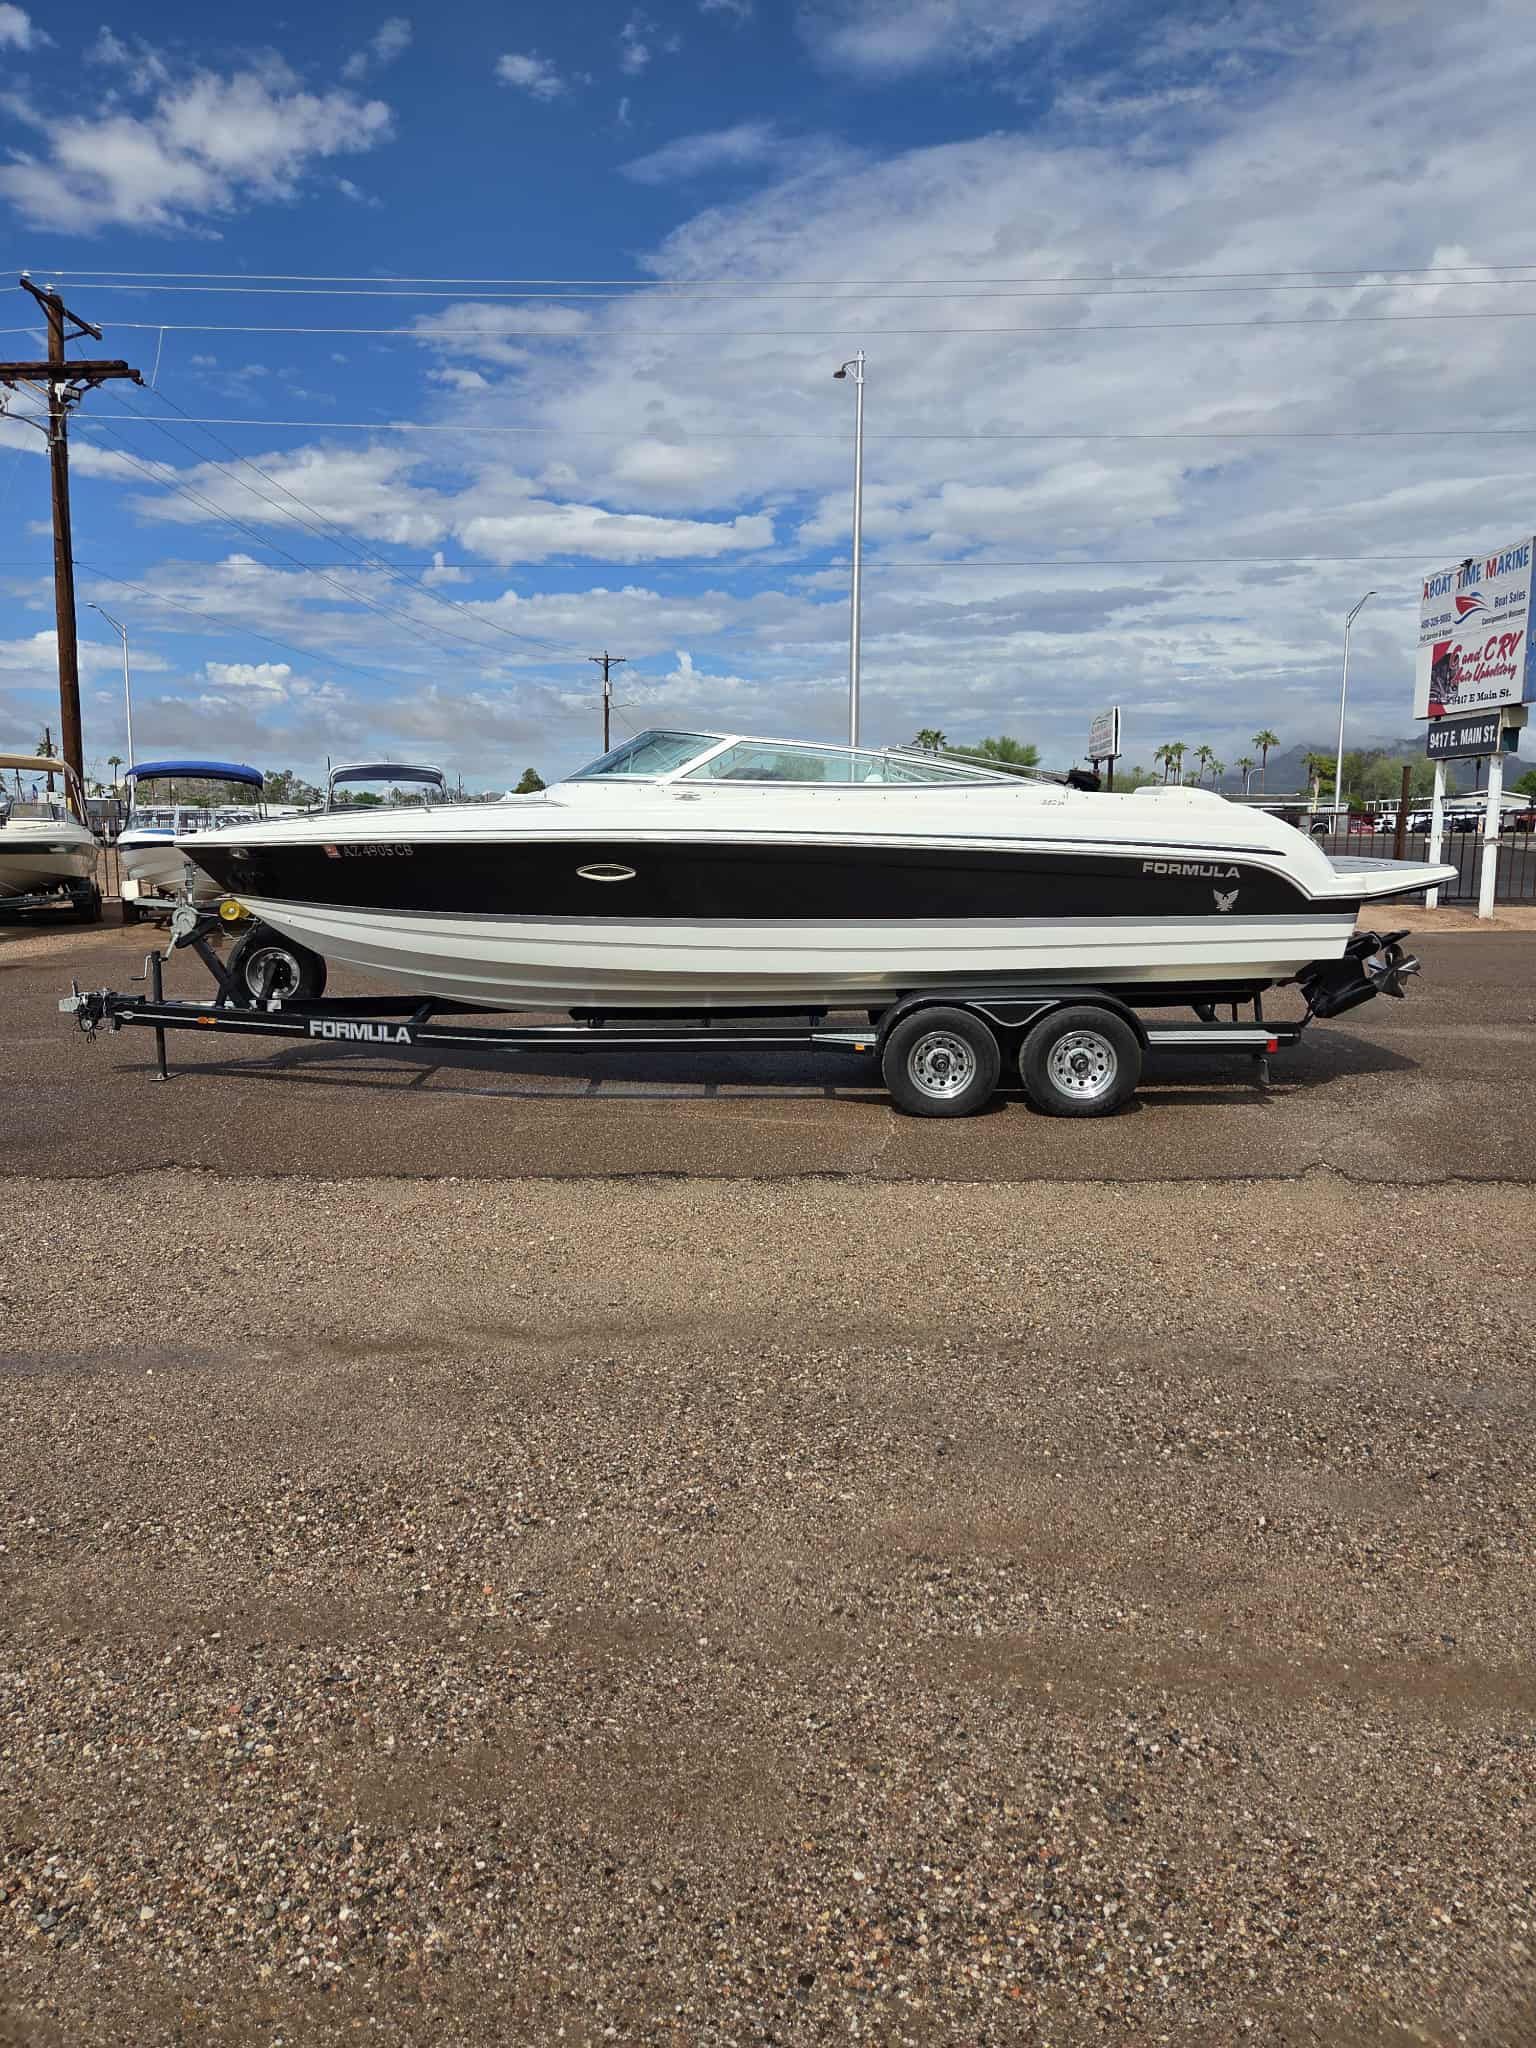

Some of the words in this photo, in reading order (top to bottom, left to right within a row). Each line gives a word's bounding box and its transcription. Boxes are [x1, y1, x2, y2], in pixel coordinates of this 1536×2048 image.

[1457, 562, 1482, 590] TIME
[1485, 545, 1530, 580] MARINE
[1494, 595, 1508, 608] Boat
[1509, 591, 1526, 603] Sales
[1462, 646, 1483, 664] and
[1469, 692, 1475, 703] E
[1477, 689, 1497, 702] Main
[1499, 688, 1512, 698] St.
[1429, 732, 1449, 748] 9417
[1450, 730, 1458, 746] E.
[1460, 726, 1482, 745] MAIN
[1483, 725, 1496, 743] ST.
[1142, 861, 1241, 879] FORMULA
[309, 1020, 412, 1044] FORMULA
